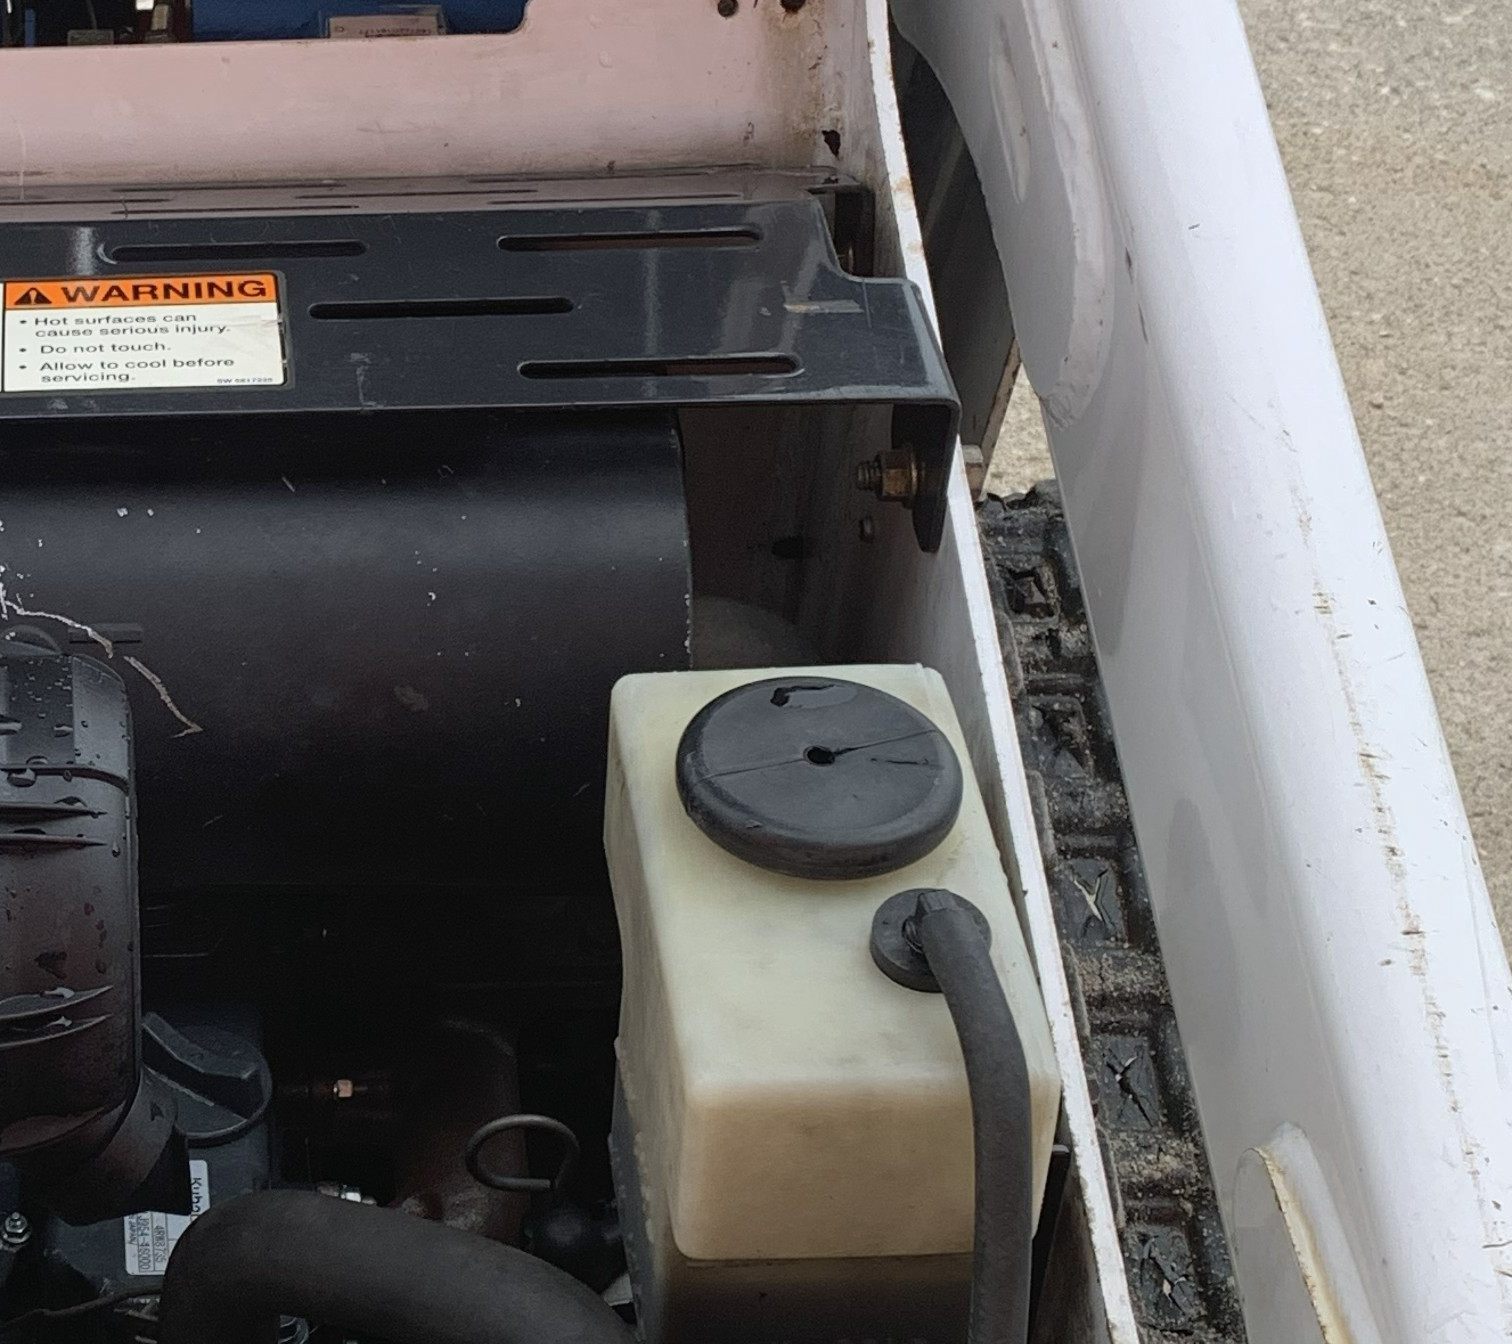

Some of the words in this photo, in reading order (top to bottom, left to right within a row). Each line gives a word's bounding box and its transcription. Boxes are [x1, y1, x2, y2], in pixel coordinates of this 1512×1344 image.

[62, 279, 268, 302] WARNING
[34, 316, 70, 327] Hot
[75, 314, 157, 326] surfaces
[162, 313, 197, 324] can
[35, 328, 93, 338] cause
[99, 326, 170, 337] serious
[174, 324, 231, 337] injury.
[40, 344, 66, 355] Do
[73, 343, 104, 354] not
[110, 341, 171, 353] touch.
[40, 361, 94, 372] Allow
[100, 360, 120, 371] to
[125, 359, 168, 370] cool
[172, 357, 235, 369] before
[40, 372, 137, 384] servicing.
